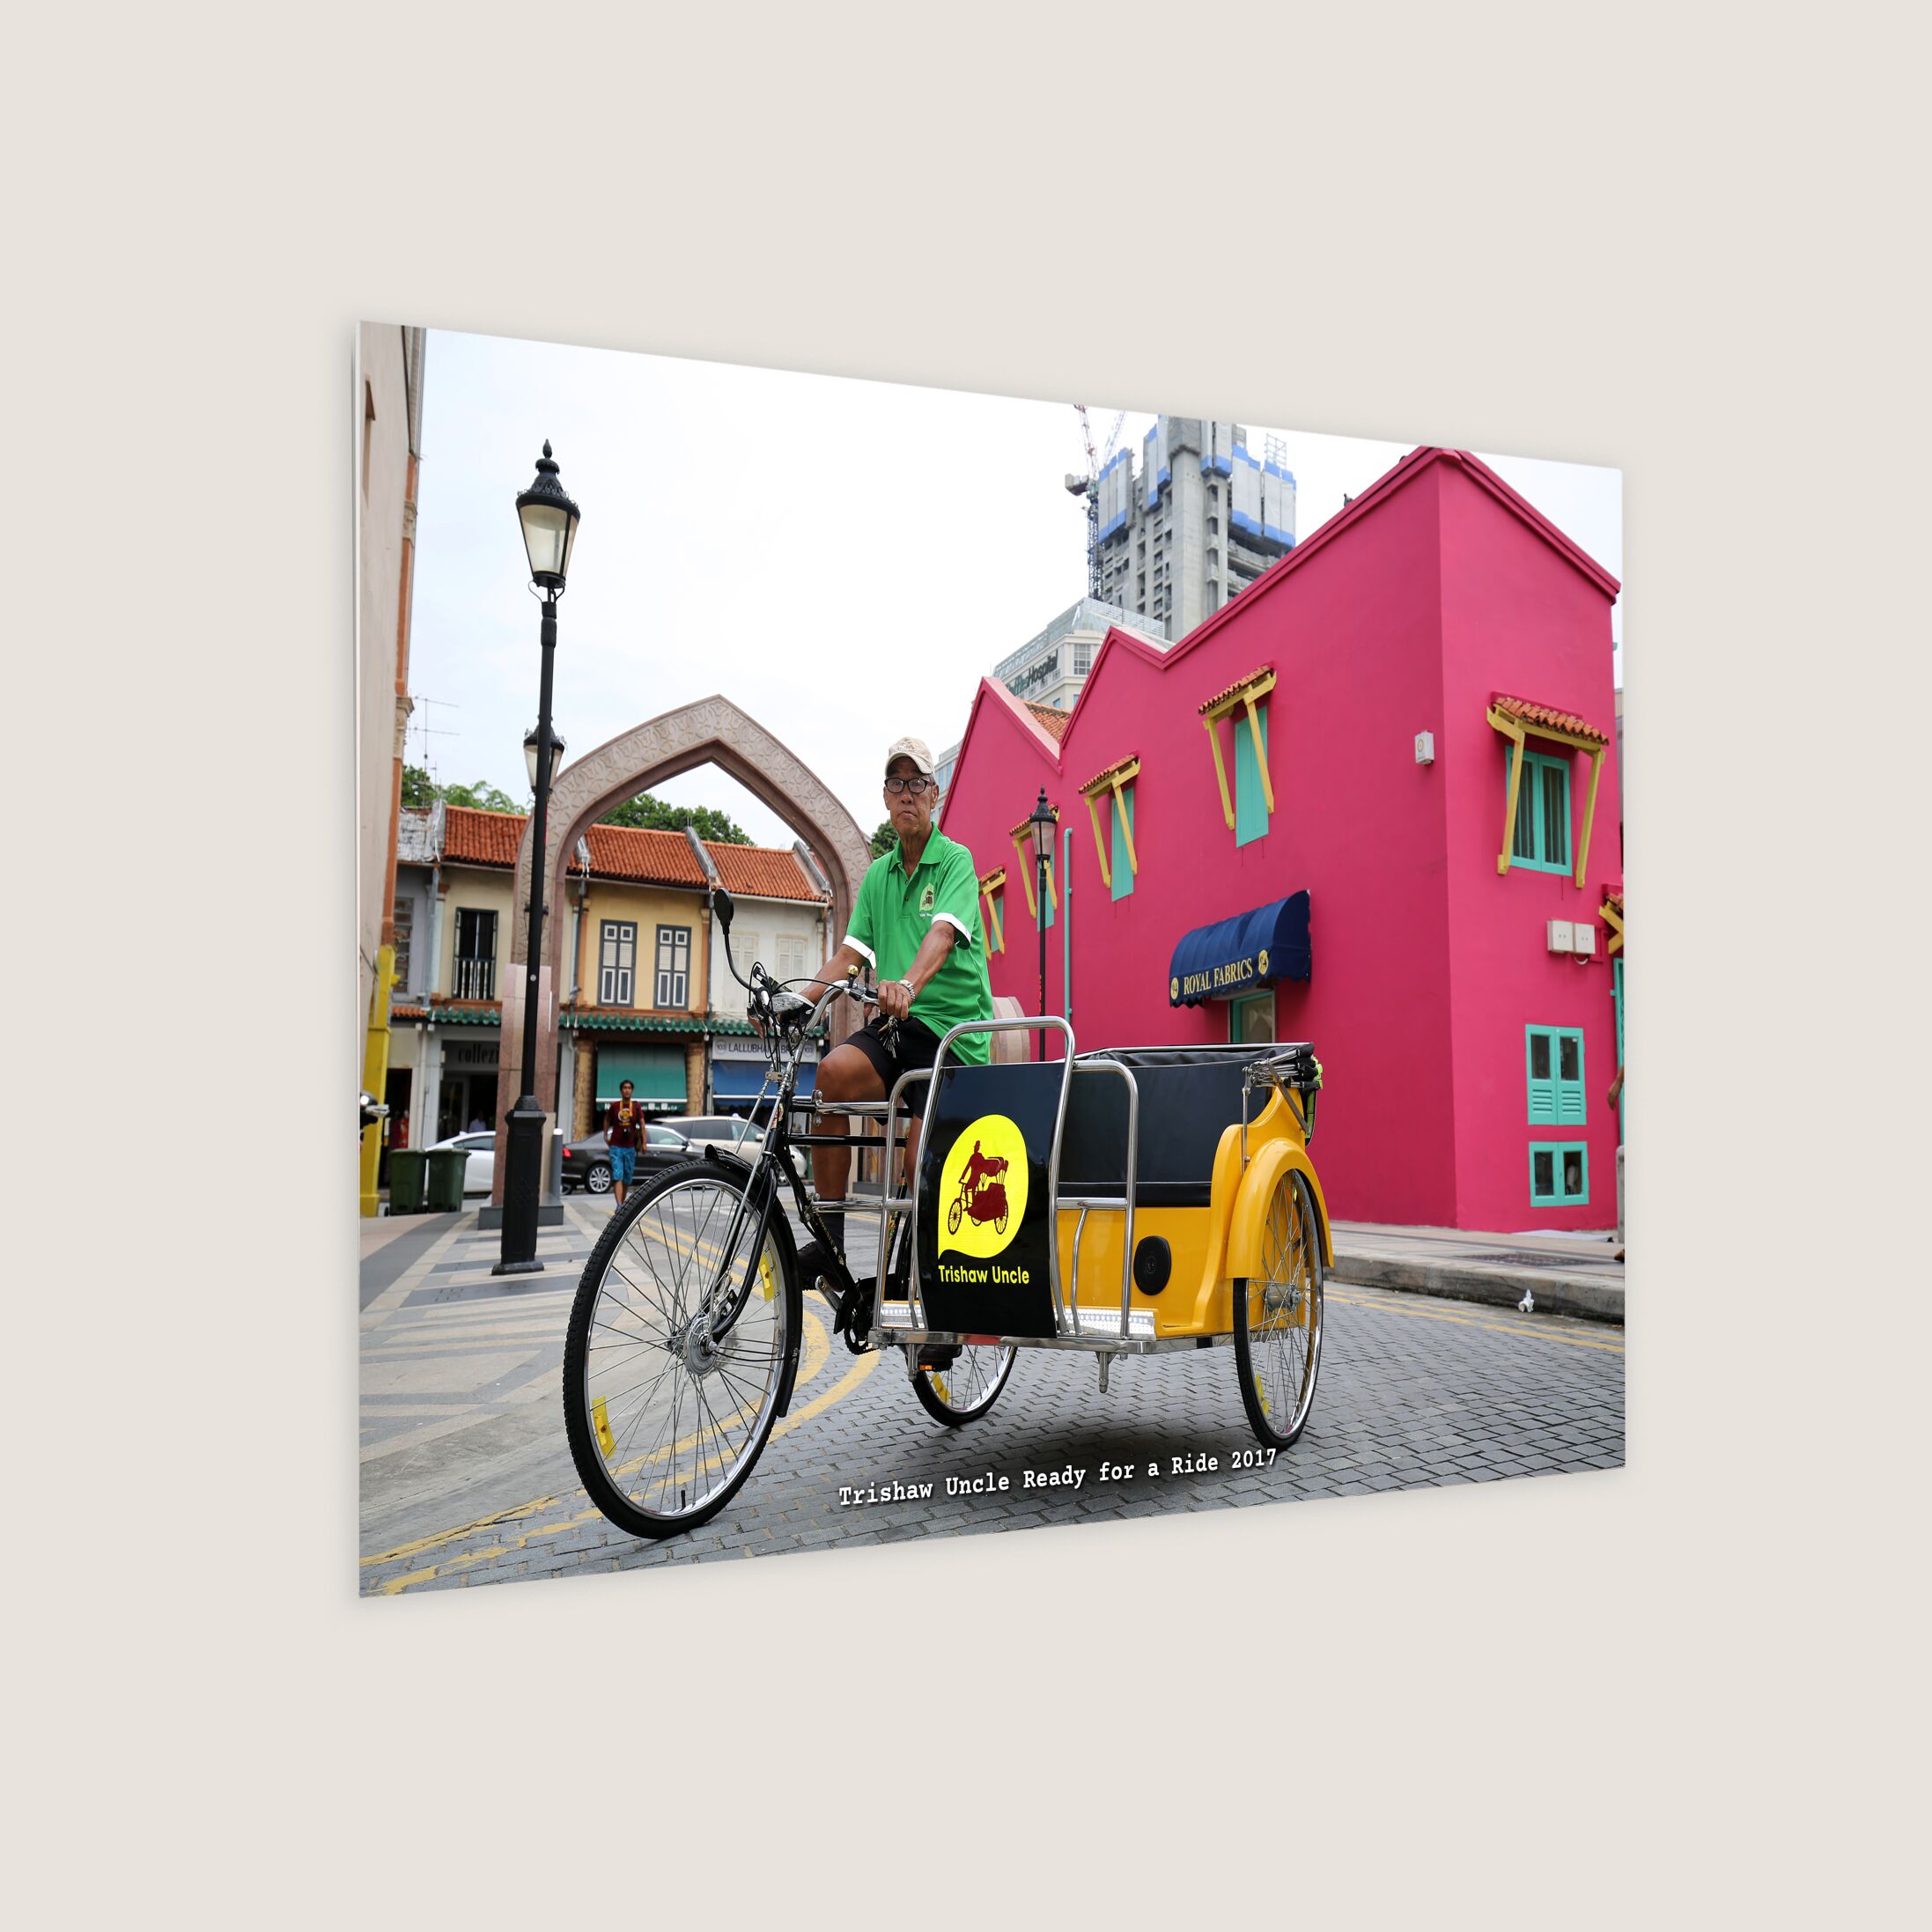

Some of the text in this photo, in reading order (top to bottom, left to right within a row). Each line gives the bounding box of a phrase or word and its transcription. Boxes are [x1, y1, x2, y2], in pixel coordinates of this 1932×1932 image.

[1183, 970, 1212, 995] ROYAL
[1213, 957, 1253, 987] FABRICS
[938, 1265, 1029, 1285] Trishaw Uncle
